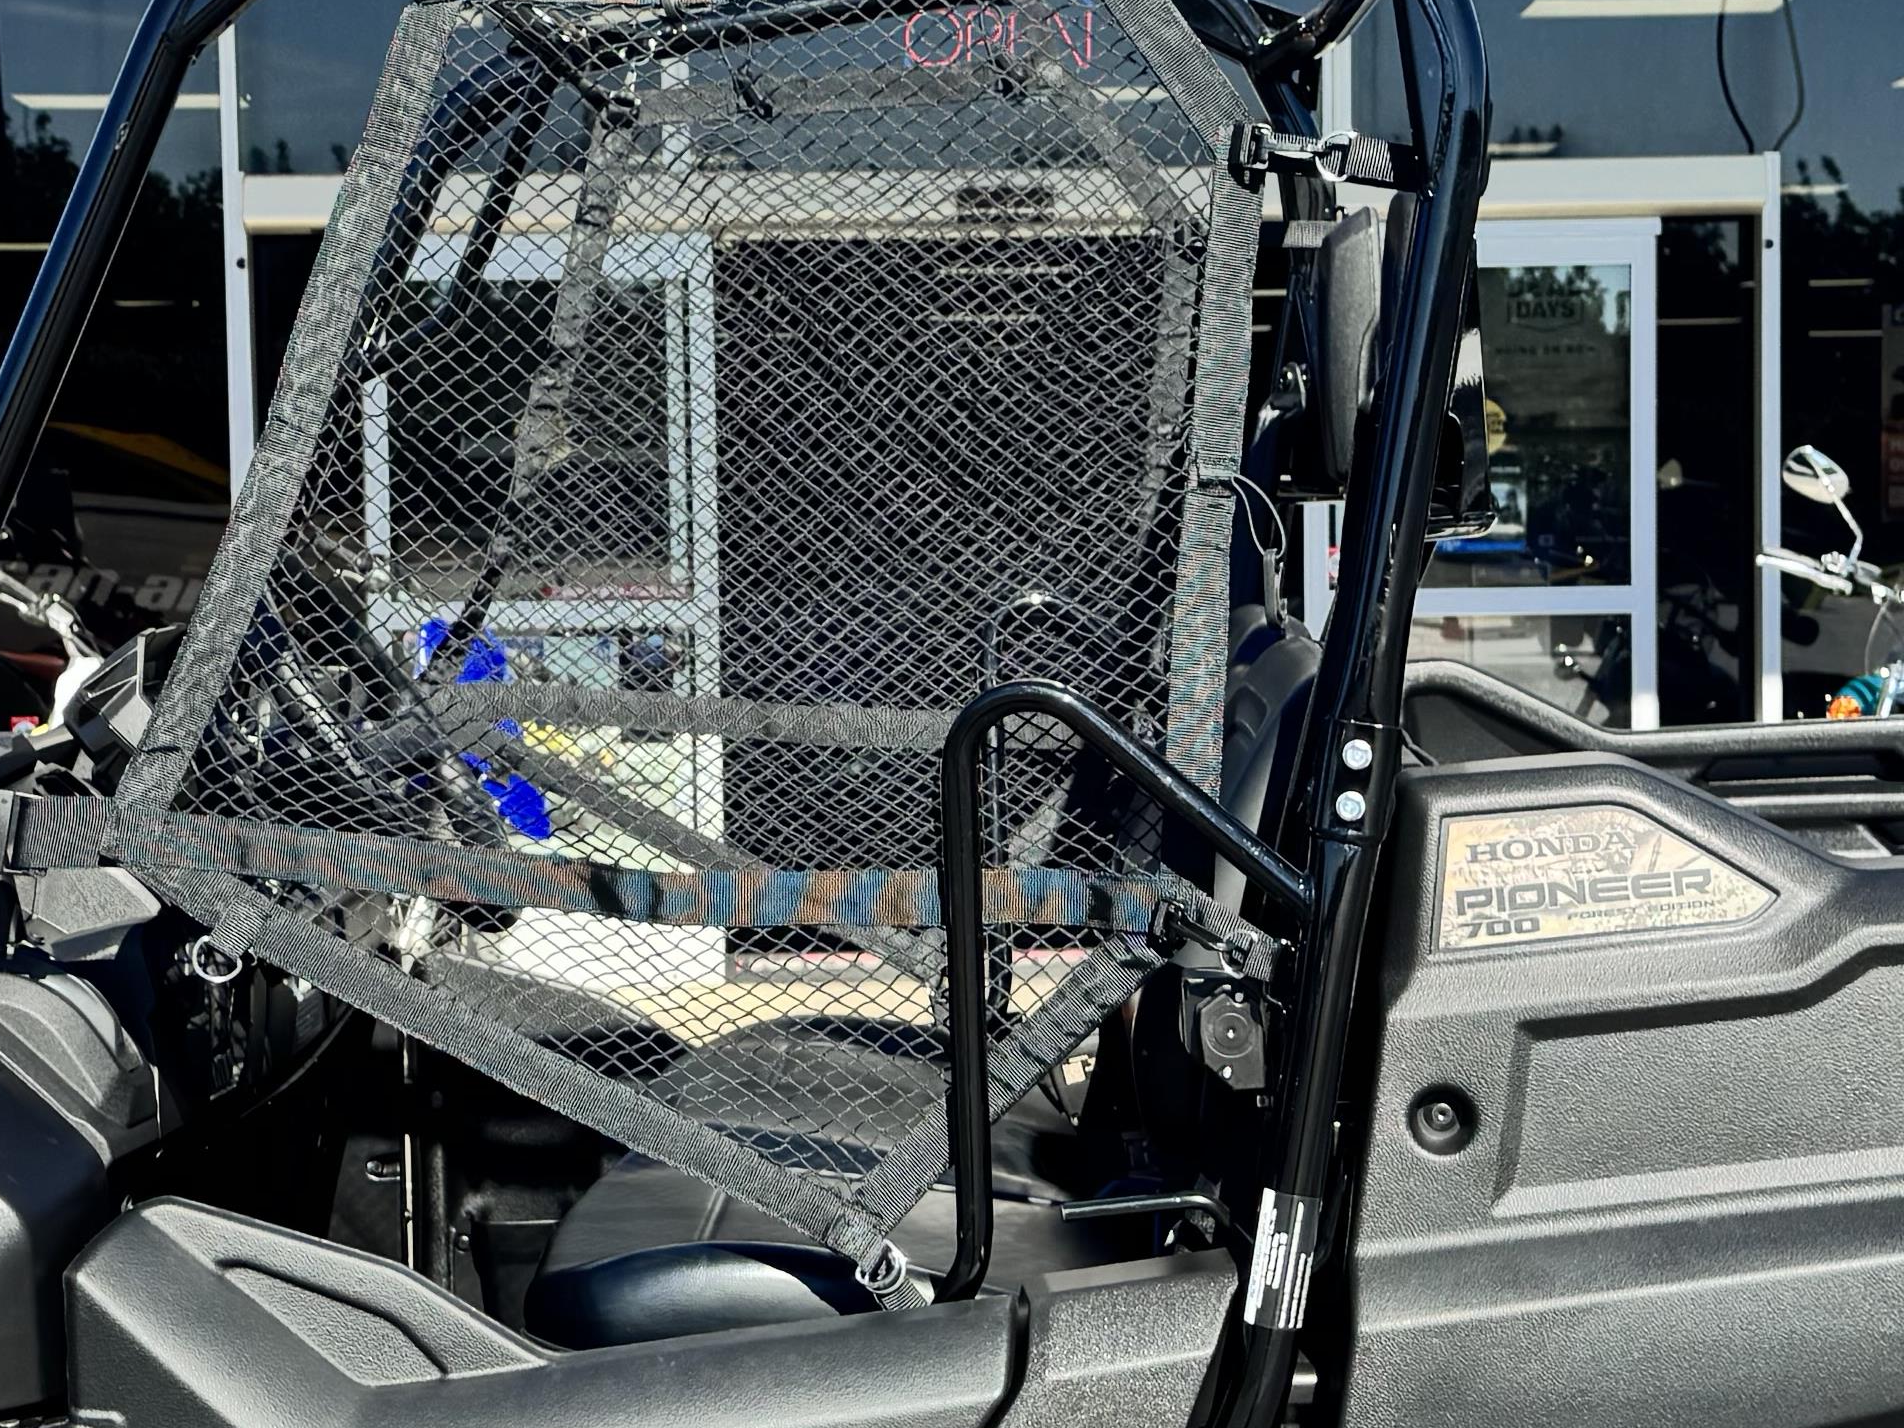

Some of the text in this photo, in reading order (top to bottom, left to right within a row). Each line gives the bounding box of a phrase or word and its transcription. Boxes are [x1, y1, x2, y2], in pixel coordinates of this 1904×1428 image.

[1515, 302, 1576, 318] DAYS
[1465, 830, 1639, 864] HONDA
[1454, 868, 1713, 917] PIONEER
[1458, 917, 1541, 940] 700
